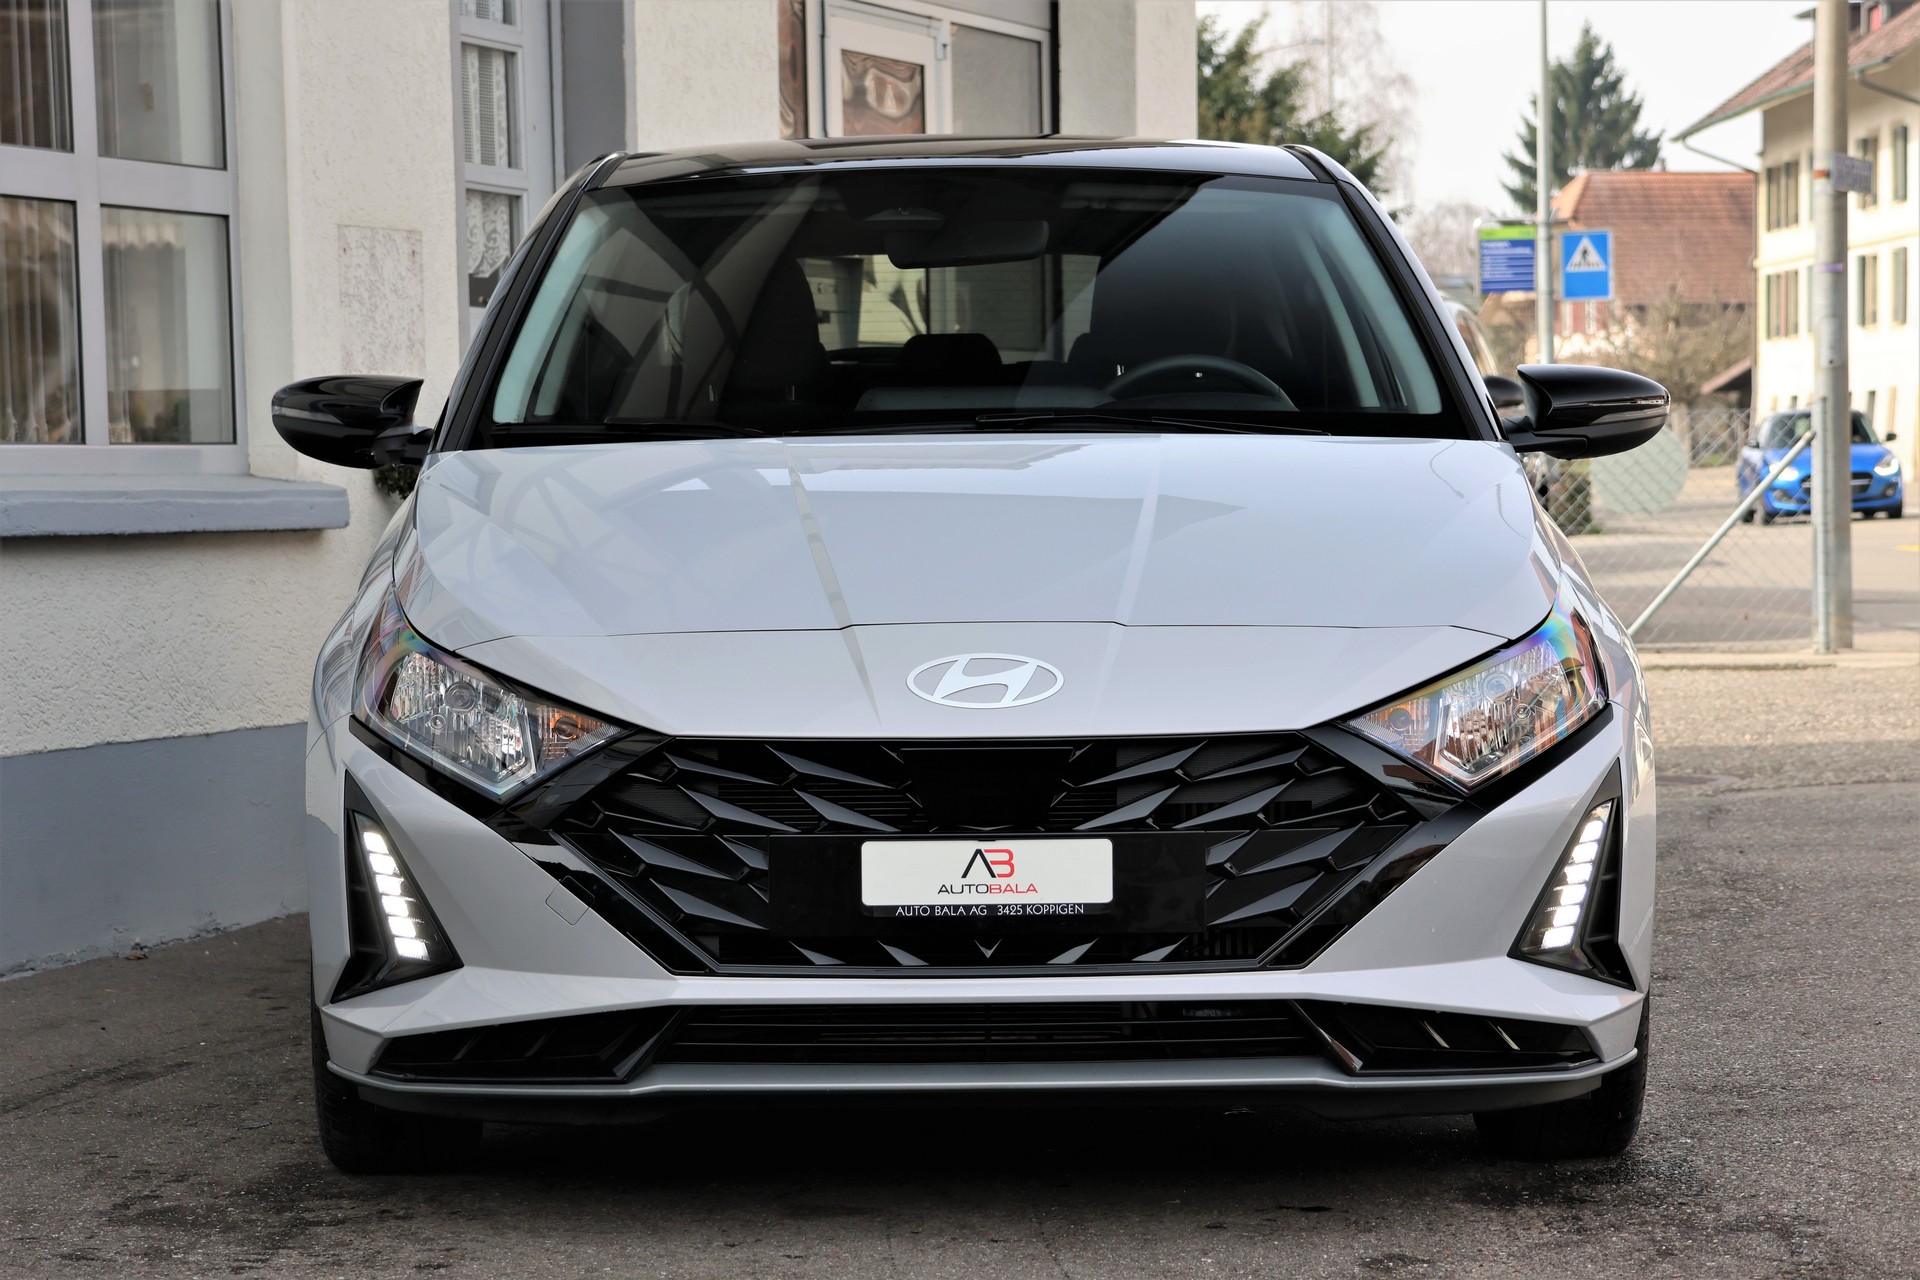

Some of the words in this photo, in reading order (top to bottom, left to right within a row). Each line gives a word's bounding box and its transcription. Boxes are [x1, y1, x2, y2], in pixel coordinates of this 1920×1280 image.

[937, 883, 1039, 895] AUTOBALA
[895, 905, 931, 917] AUTO
[934, 905, 966, 916] BALA
[969, 905, 988, 916] AG
[997, 904, 1023, 915] 3425
[1026, 903, 1085, 915] KOPPIGEN
